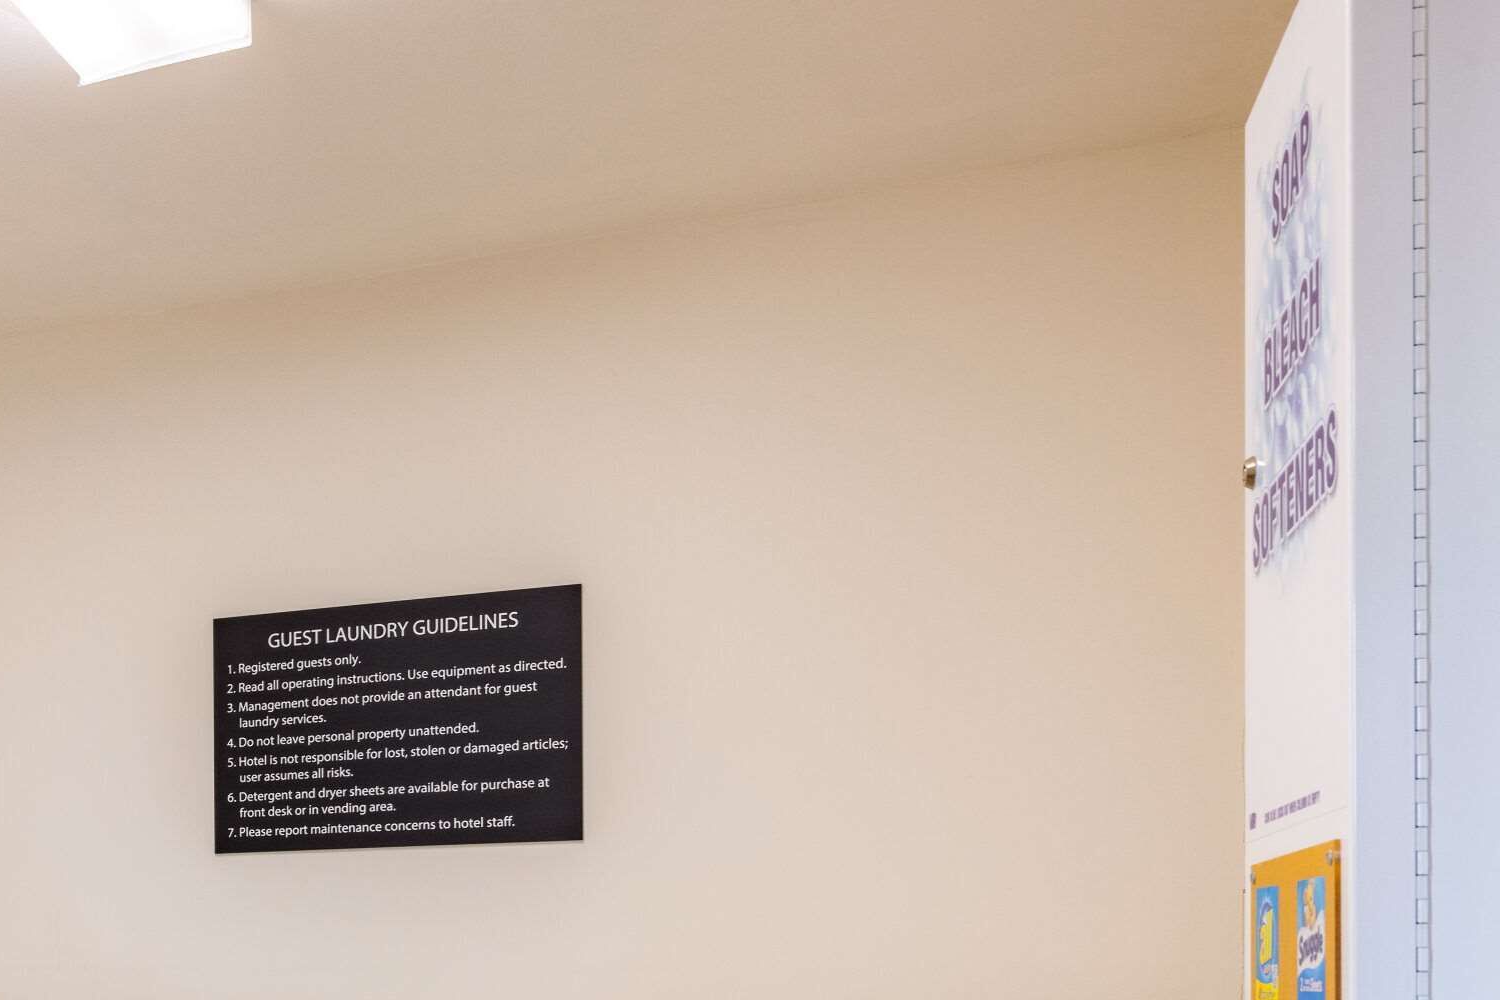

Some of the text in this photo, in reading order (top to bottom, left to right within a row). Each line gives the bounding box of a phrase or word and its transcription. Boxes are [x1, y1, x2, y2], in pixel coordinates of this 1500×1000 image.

[1271, 108, 1310, 241] SOAP
[1264, 256, 1320, 406] BLEACH
[1252, 408, 1337, 570] SOFTENERS
[268, 611, 518, 648] GUEST LAUNDRY GUIDELINES
[227, 657, 567, 694] 2. Read all operating instructions. Use equipment as directed.
[228, 653, 361, 675] 1. Registered guests only.
[227, 681, 537, 713] 3. Management does not provide an attendant for guest
[239, 713, 327, 728] laundry services.
[227, 722, 479, 748] 4. Do not leave personal property unattended.
[228, 738, 568, 768] 5. Hotel is not responsible for lost, stolen or damaged articles;
[240, 767, 354, 783] user assumes all risks.
[227, 777, 550, 803] 6. Detergent and dryer sheets are available for purchase at
[239, 802, 396, 818] front desk or in vending area.
[228, 815, 515, 838] 7. Please report maintenance concerns to hotel staff.
